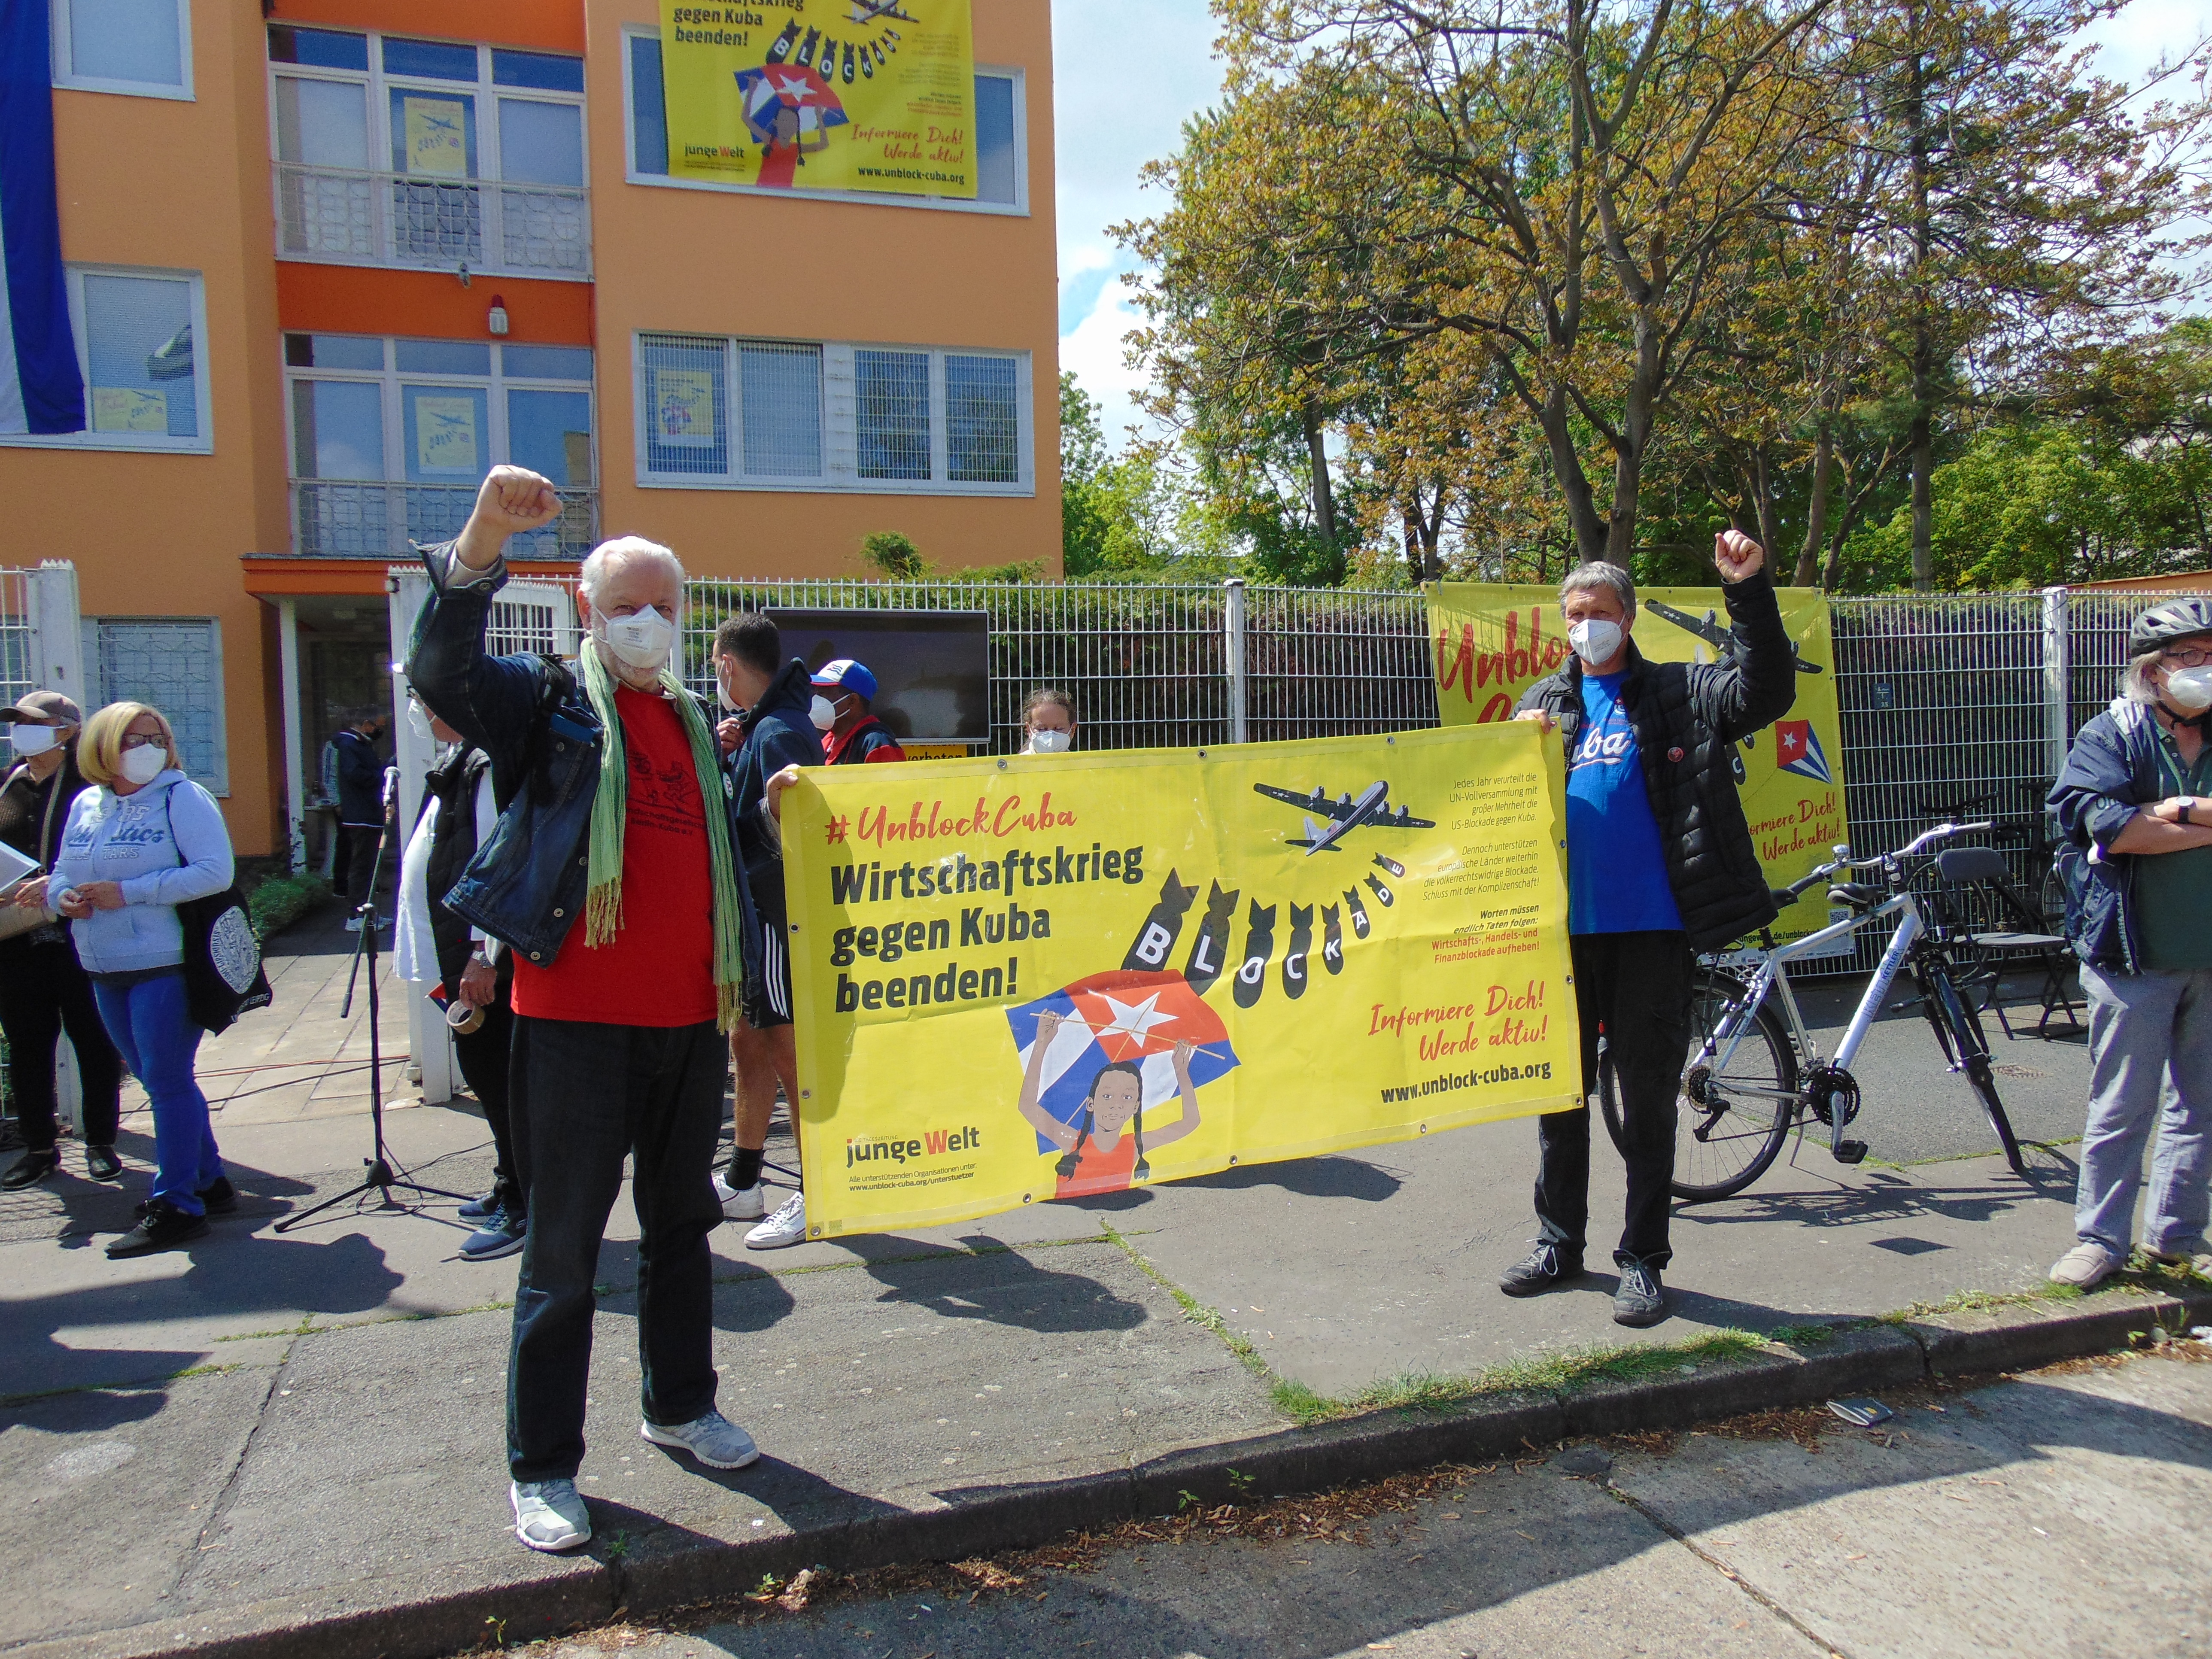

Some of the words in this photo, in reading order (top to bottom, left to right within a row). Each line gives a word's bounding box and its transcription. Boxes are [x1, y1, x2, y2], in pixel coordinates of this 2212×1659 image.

[674, 7, 720, 24] gegen
[725, 8, 763, 26] Kuba
[675, 25, 747, 46] beenden!
[851, 124, 919, 142] Informiere
[926, 126, 963, 145] Dich!
[684, 143, 717, 158] junge
[719, 146, 744, 158] Welt
[884, 143, 923, 159] Werde
[858, 167, 965, 185] www.unblock-cuba.org
[1438, 606, 1574, 703] Unblo
[1453, 778, 1474, 789] Jedes
[1477, 777, 1492, 787] Jahr
[1493, 773, 1524, 785] verurteilt
[1526, 772, 1537, 782] die
[1449, 787, 1524, 802] UN-Vollversammlung
[1525, 786, 1537, 795] mit
[1472, 803, 1494, 816] großer
[1495, 800, 1525, 811] Mehrheit
[1527, 799, 1537, 808] die
[1749, 814, 1796, 836] ormiere
[1797, 792, 1835, 823] Dich!
[1451, 816, 1495, 830] US-Blockade
[1496, 815, 1516, 826] gegen
[1517, 812, 1537, 823] Kuba.
[1462, 843, 1493, 856] Dennoch
[1494, 839, 1537, 852] unterstützen
[1762, 827, 1805, 860] Werde
[1808, 817, 1841, 845] aktiv!
[1437, 858, 1478, 872] europäische
[1480, 856, 1504, 866] Länder
[1505, 851, 1538, 863] weiterhin
[830, 842, 1144, 905] Wirtschaftskrieg
[1424, 878, 1435, 887] die
[1437, 869, 1504, 886] völkerrechtswidrige
[1505, 864, 1539, 877] Blockade.
[1422, 889, 1448, 901] Schluss
[1450, 887, 1462, 897] mit
[1464, 885, 1476, 895] der
[1478, 877, 1540, 893] Komplizenschaft!
[1480, 908, 1508, 920] Worten
[1510, 905, 1539, 915] müssen
[830, 918, 950, 967] gegen
[959, 902, 1051, 947] Kuba
[1453, 923, 1484, 934] endlich
[1486, 921, 1509, 930] Taten
[1510, 917, 1538, 928] folgen:
[1431, 936, 1484, 950] Wirtschafts-,
[1485, 931, 1521, 943] Handels-
[1523, 928, 1538, 938] und
[1434, 946, 1495, 963] Finanzblockade
[1497, 941, 1540, 955] aufheben!
[1882, 950, 1899, 979] KETTLER
[835, 956, 1017, 1013] beenden!
[1368, 1003, 1475, 1038] Informiere
[1484, 980, 1545, 1016] Dich!
[1419, 1021, 1480, 1061] Werde
[1489, 1014, 1548, 1047] aktiv!
[1381, 1061, 1552, 1103] www.unblock-cuba.org
[846, 1138, 921, 1169] junge
[924, 1125, 980, 1155] Welt
[849, 1171, 975, 1191] www.unblock-cuba.org/unterstuetzer
[862, 1172, 913, 1182] unterstützenden
[914, 1165, 959, 1178] Organisationen
